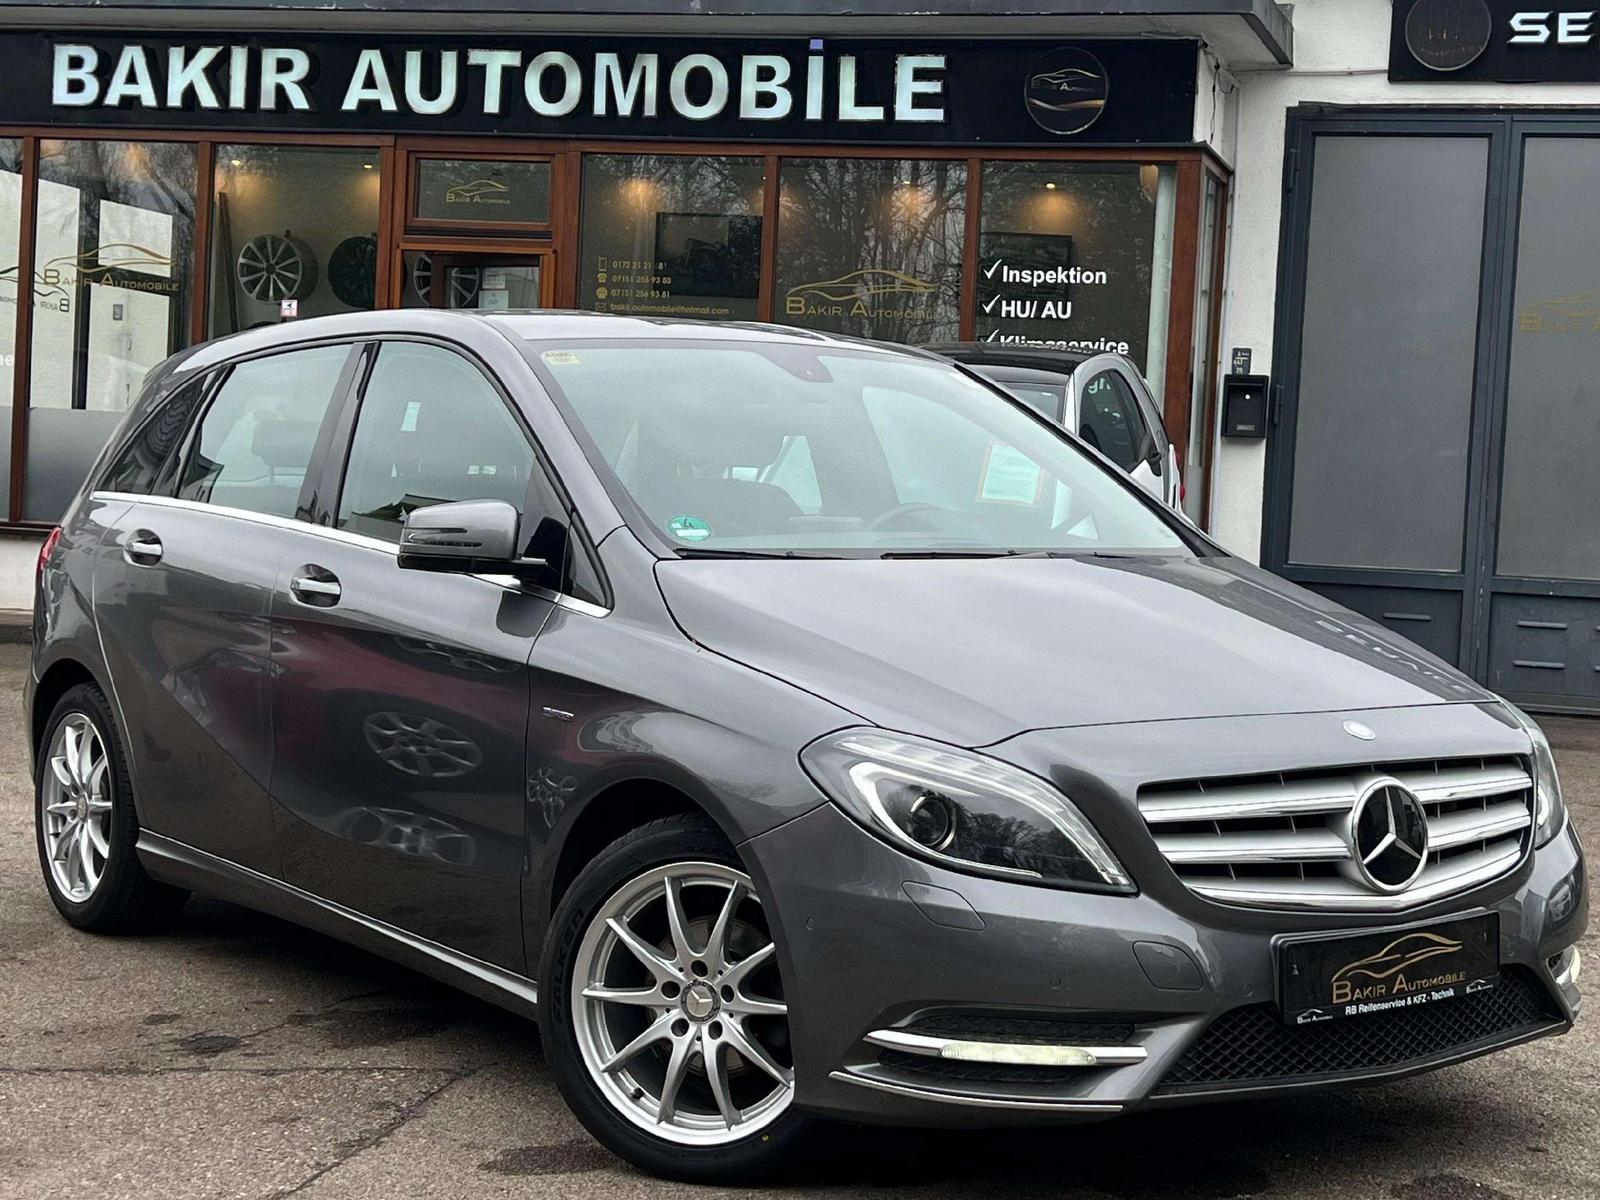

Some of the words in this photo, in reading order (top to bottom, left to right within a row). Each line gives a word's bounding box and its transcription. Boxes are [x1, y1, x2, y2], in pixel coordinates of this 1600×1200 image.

[52, 44, 310, 111] BAKIR
[1002, 265, 1107, 287] Inspektion
[1040, 301, 1072, 319] AU
[1332, 980, 1386, 1004] BAKIR
[1392, 971, 1466, 994] AUTOMOBILE
